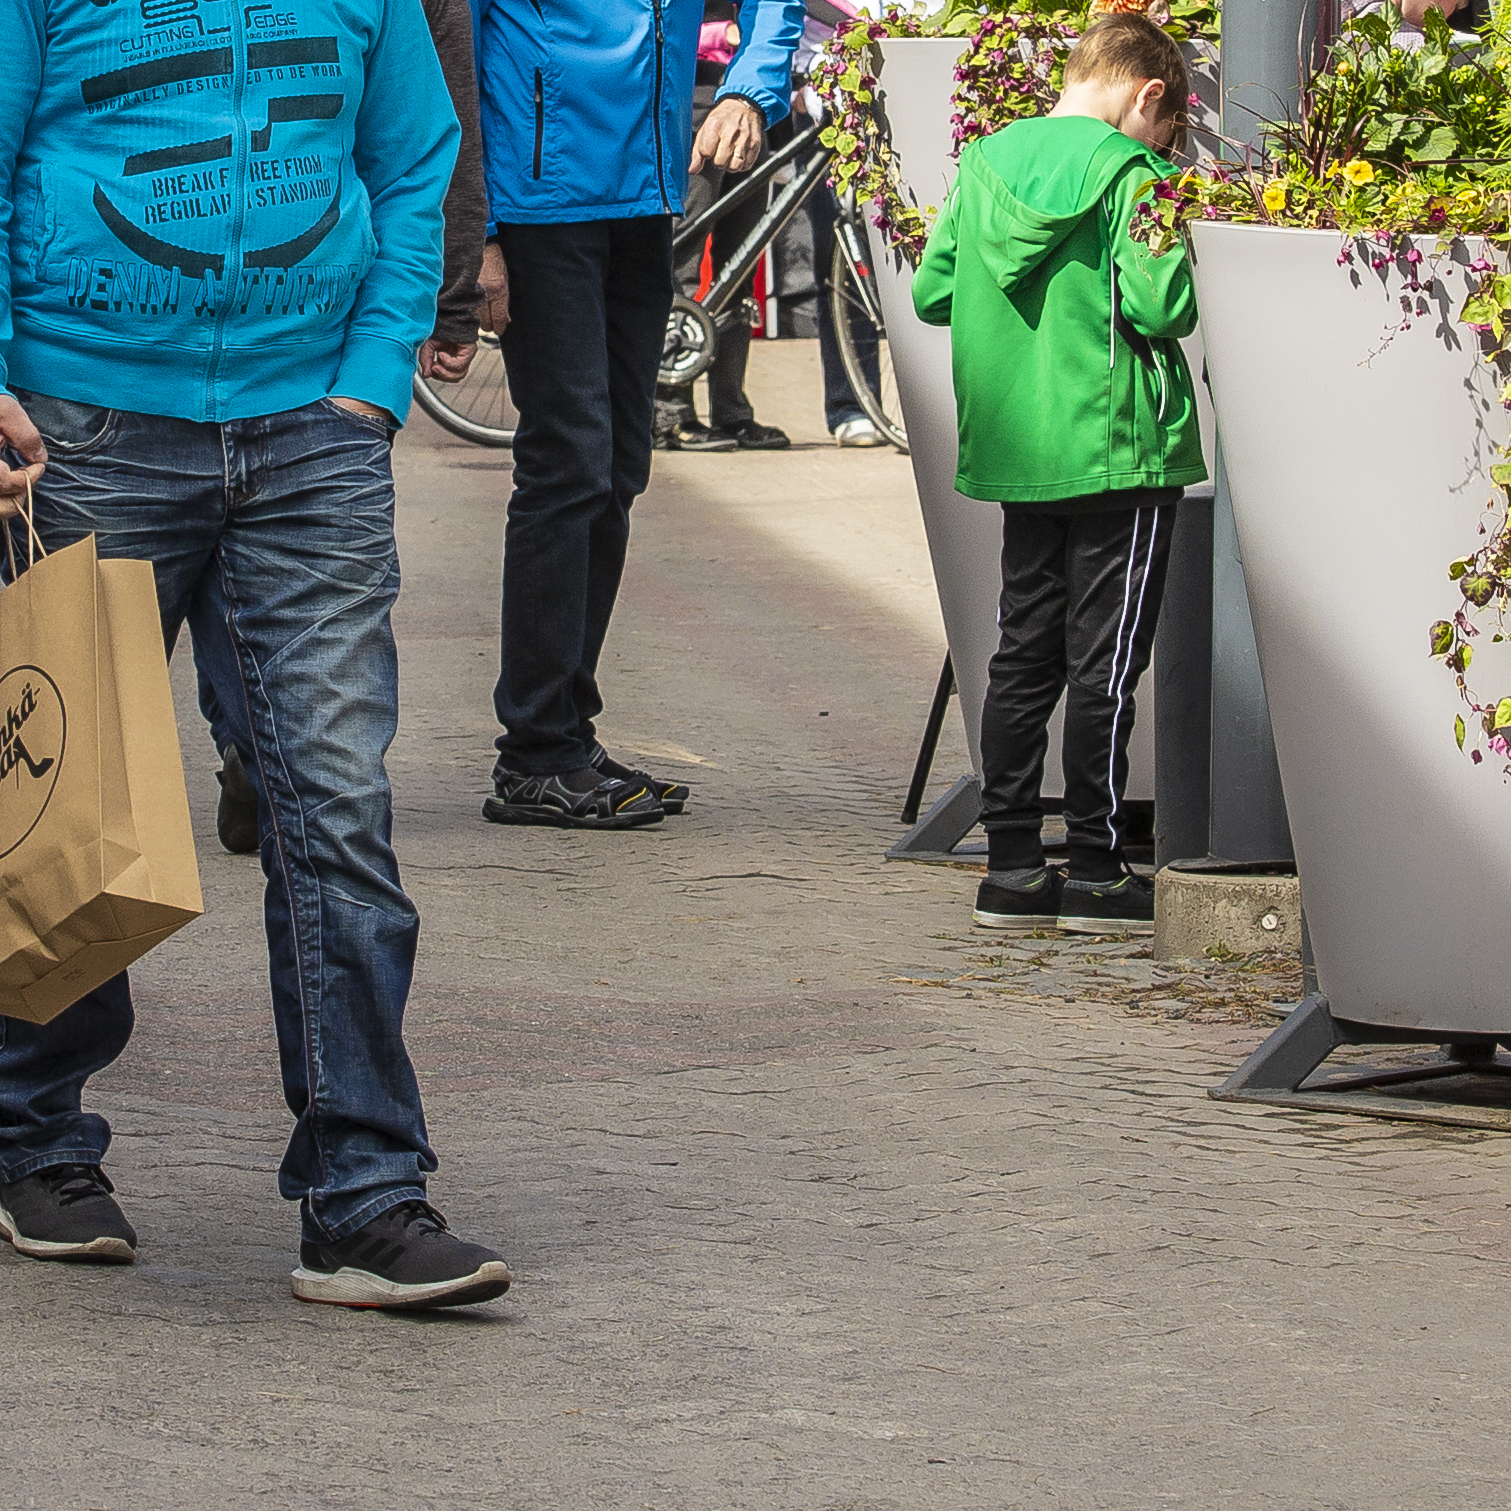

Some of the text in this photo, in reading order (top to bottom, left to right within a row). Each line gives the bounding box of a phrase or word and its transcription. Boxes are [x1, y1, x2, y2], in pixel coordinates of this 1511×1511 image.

[119, 11, 298, 53] CUTTING EDGE
[267, 67, 284, 82] TO
[290, 64, 306, 80] BE
[152, 170, 216, 199] BREAK
[284, 154, 323, 178] FROM
[67, 257, 181, 316] DENIM
